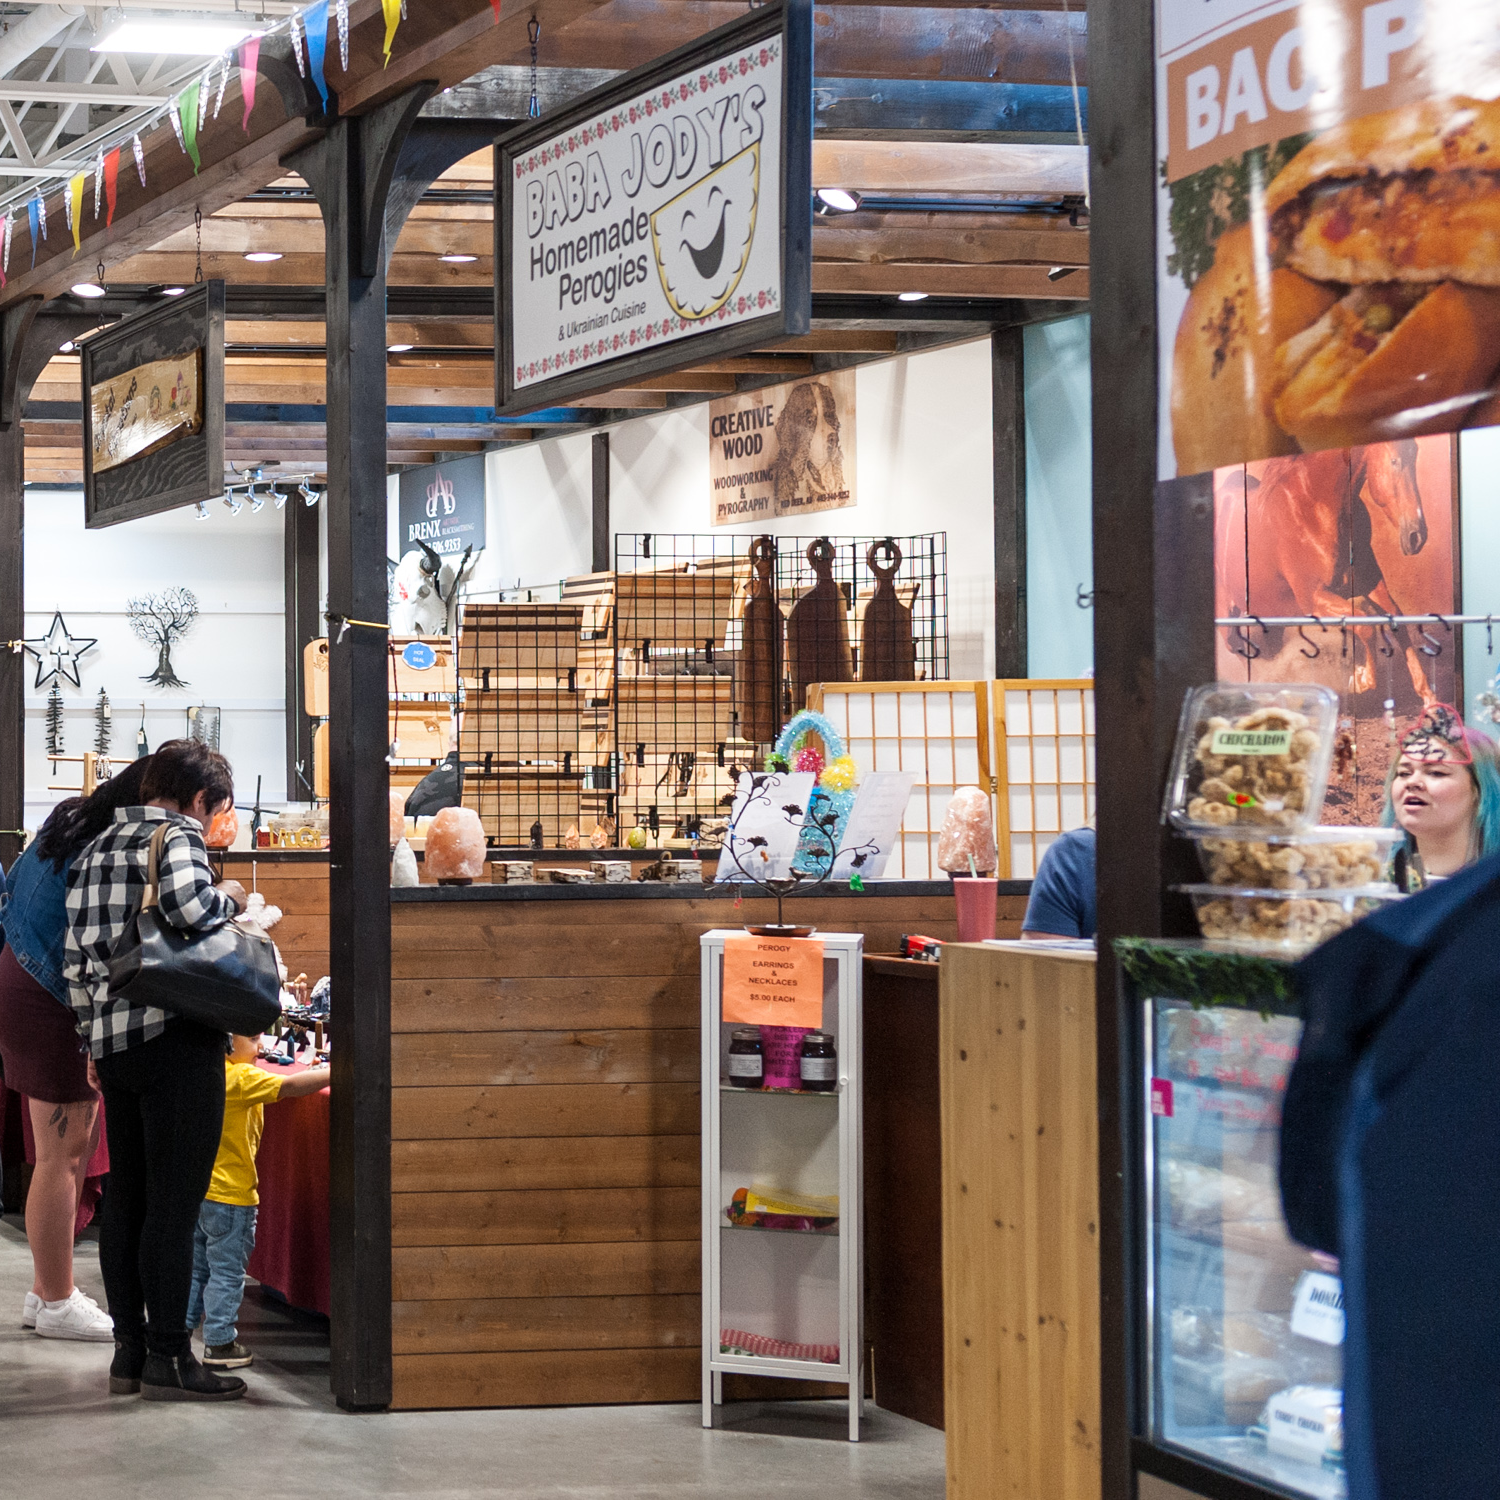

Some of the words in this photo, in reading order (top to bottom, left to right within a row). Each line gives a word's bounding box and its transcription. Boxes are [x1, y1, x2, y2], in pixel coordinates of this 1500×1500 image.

[526, 151, 611, 239] BABA
[621, 84, 767, 198] JODY'S
[531, 206, 648, 281] Homemade
[559, 253, 648, 310] Perogies
[558, 325, 565, 341] &
[566, 311, 608, 340] Ukrainian
[611, 301, 646, 325] Cuisine
[711, 404, 774, 438] CREATIVE
[722, 433, 763, 460] WOOD
[713, 468, 774, 490] WOODWORKING
[739, 487, 746, 499] &
[717, 496, 770, 516] PYROGRAPHY
[408, 519, 441, 542] BRENX
[757, 944, 791, 952] PEROGY
[752, 960, 795, 969] EARRINGS
[748, 977, 798, 986] NECKLACES
[750, 993, 771, 1001] $5.00
[772, 994, 796, 1003] EACH
